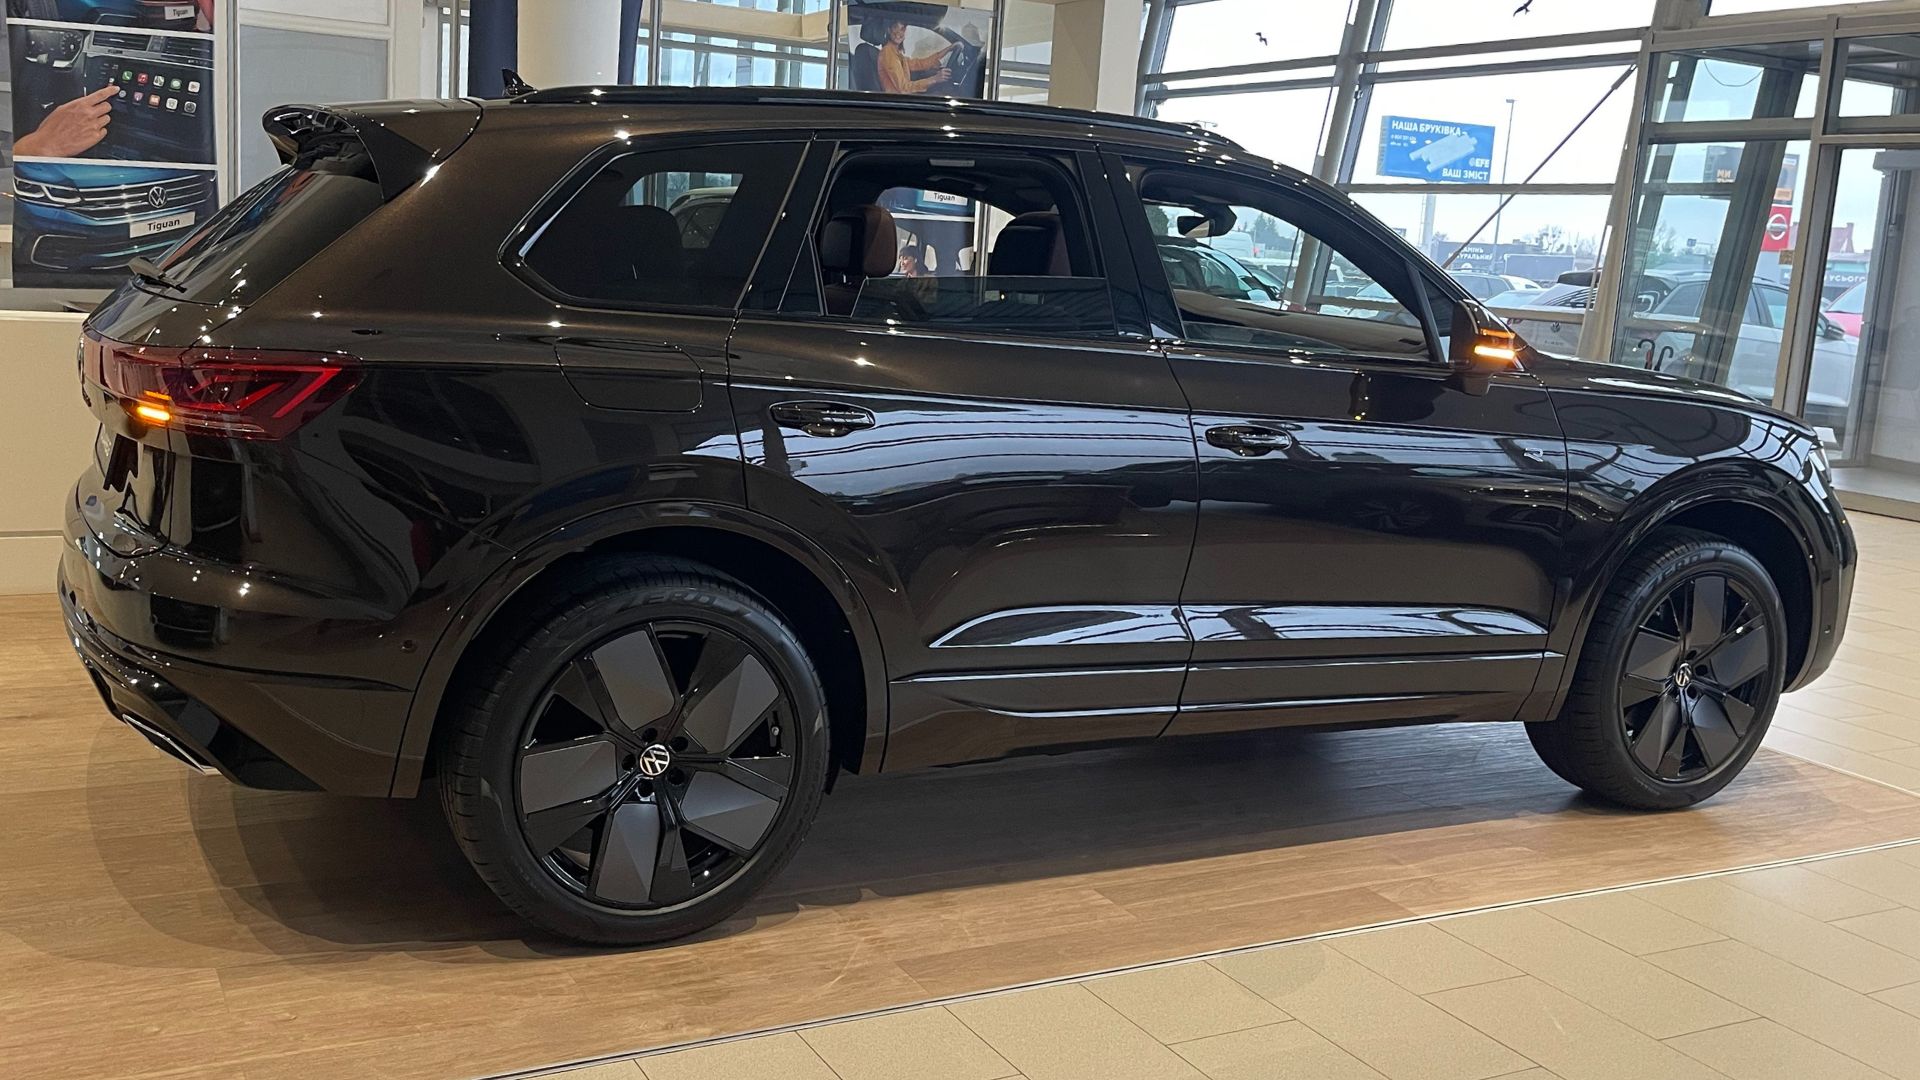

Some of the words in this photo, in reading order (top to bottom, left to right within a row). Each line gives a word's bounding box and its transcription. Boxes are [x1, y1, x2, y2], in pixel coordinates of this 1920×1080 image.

[1392, 120, 1418, 132] НАША
[1419, 123, 1461, 137] БРУКІВКА
[1442, 168, 1461, 178] ВАШ
[1463, 170, 1488, 181] ЗМІСТ
[934, 192, 956, 202] Tiguan
[147, 219, 180, 232] Tiguan
